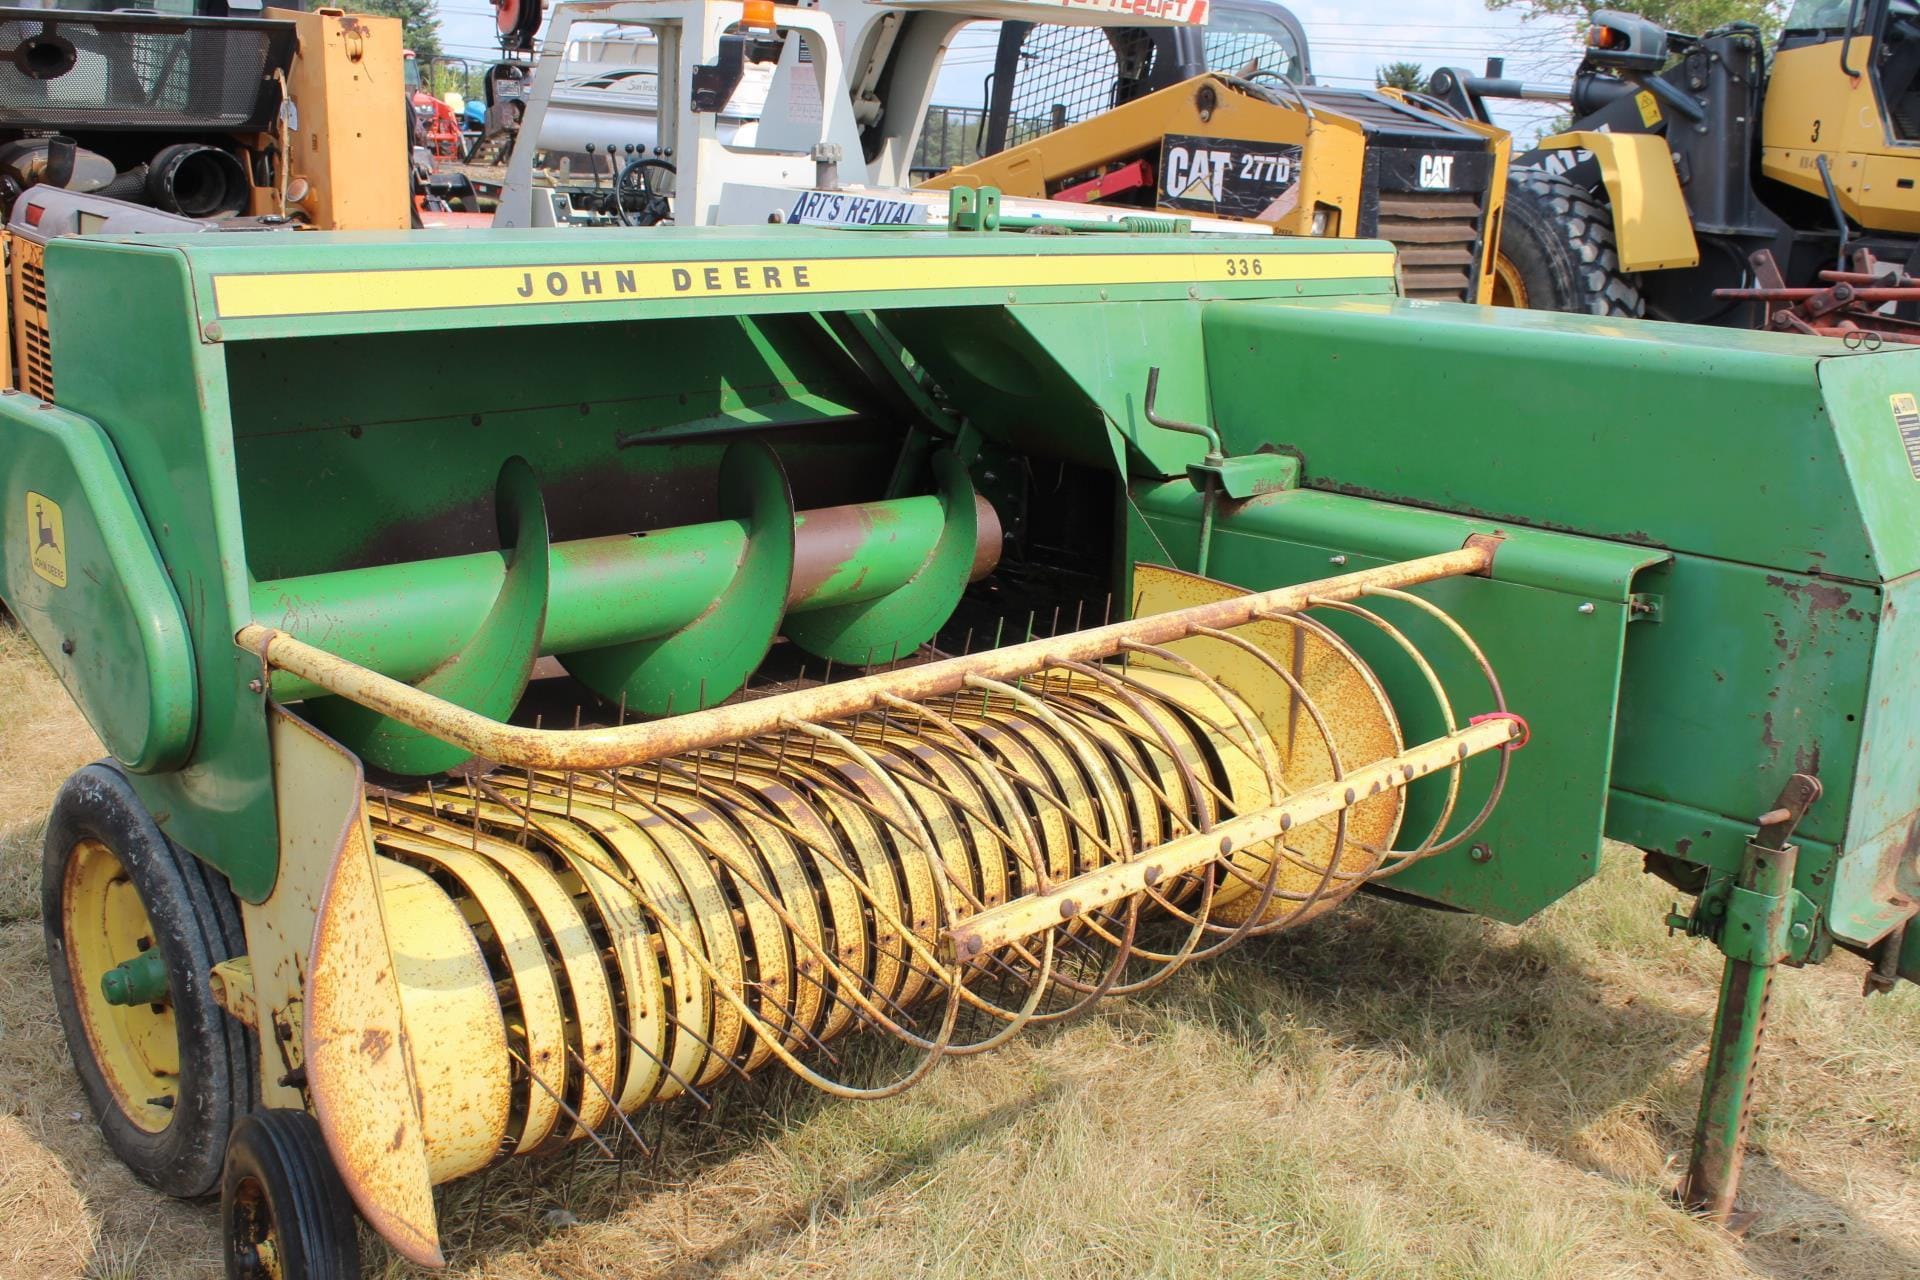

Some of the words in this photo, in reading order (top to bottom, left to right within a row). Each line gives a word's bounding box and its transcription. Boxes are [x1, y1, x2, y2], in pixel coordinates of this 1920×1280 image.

[1811, 119, 1821, 143] 3
[1166, 147, 1232, 203] CAT
[1239, 153, 1290, 183] 277D
[1420, 154, 1454, 189] CAT
[787, 191, 844, 225] ART'S
[517, 269, 638, 298] JOHN
[671, 265, 811, 292] DEERE
[1226, 258, 1263, 277] 336
[34, 557, 48, 572] JOHN
[47, 563, 65, 581] DEERE
